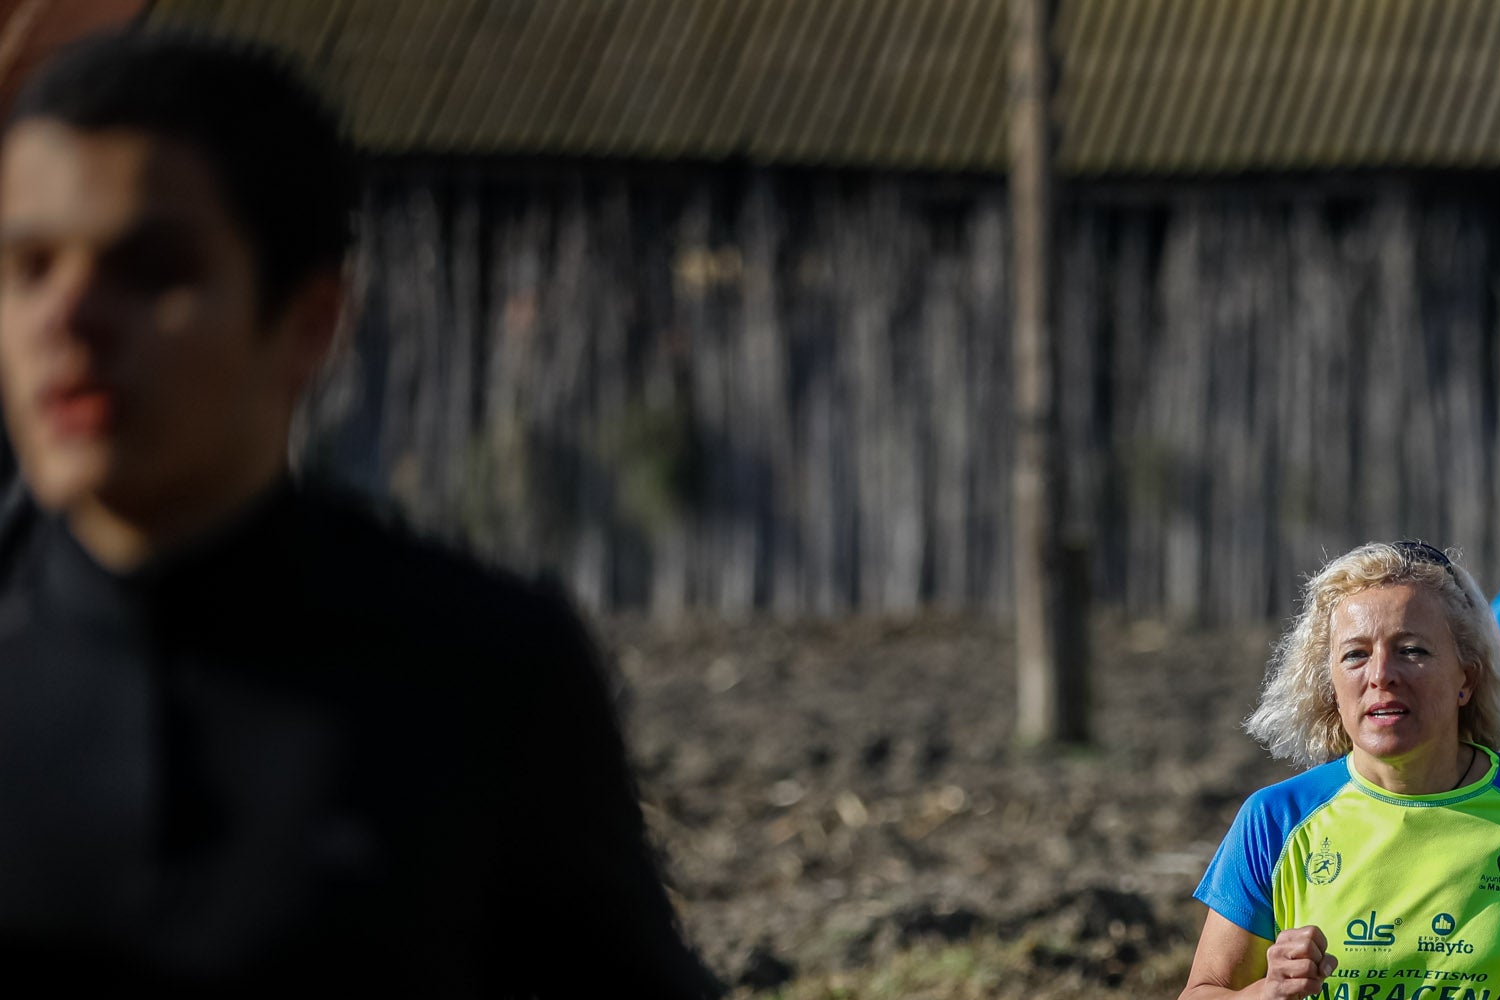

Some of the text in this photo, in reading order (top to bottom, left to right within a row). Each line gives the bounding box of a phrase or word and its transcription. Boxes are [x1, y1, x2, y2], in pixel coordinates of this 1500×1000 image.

[1344, 910, 1395, 946] als
[1417, 940, 1474, 956] mayfo
[1366, 969, 1389, 979] DE
[1393, 969, 1488, 983] ATLETISMO
